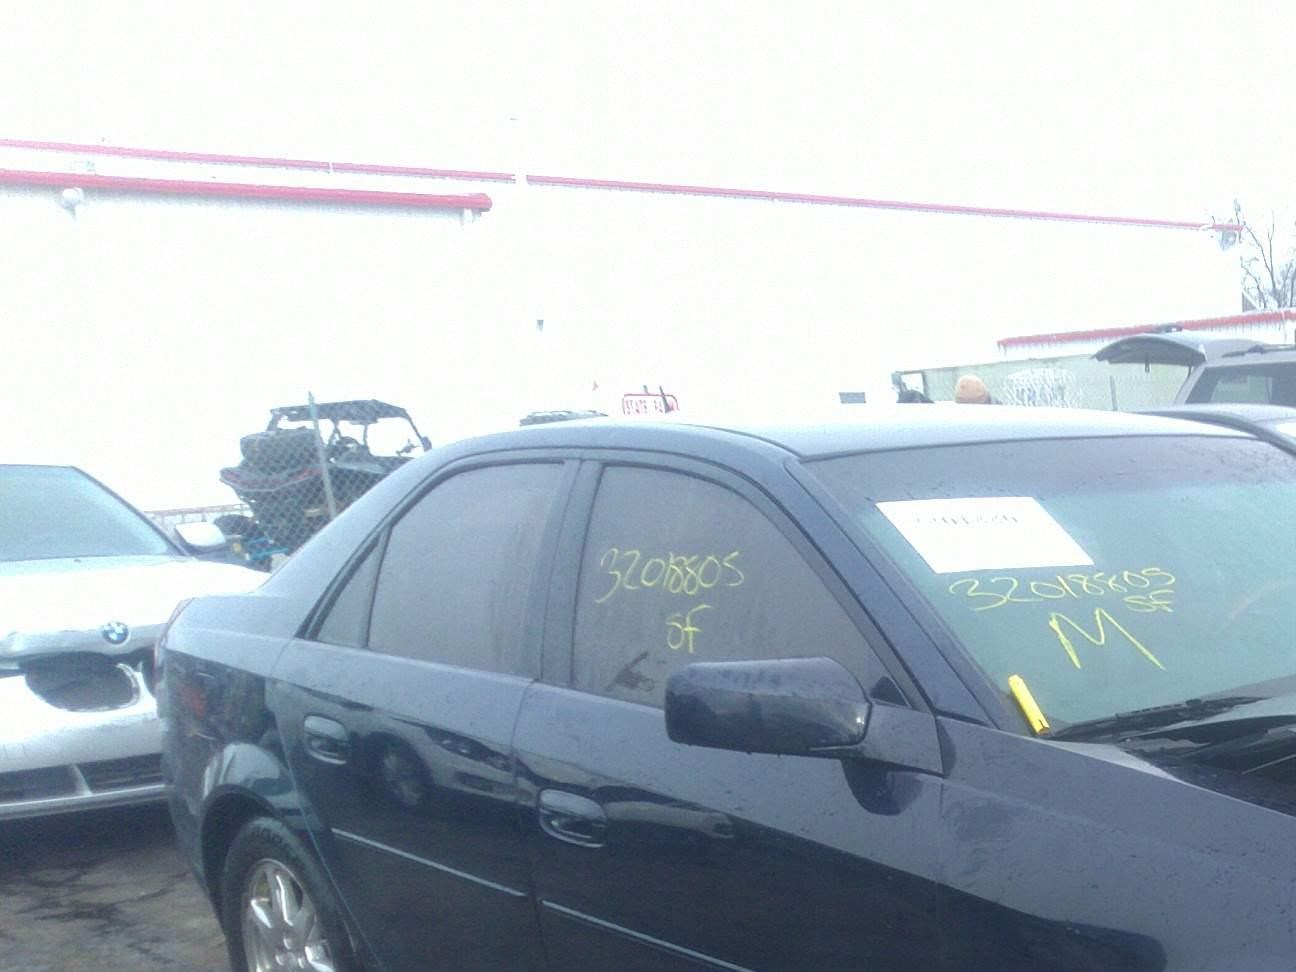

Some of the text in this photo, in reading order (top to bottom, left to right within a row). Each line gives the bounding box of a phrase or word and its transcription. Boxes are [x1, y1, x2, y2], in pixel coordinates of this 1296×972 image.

[595, 547, 745, 604] 32018805
[948, 567, 1176, 612] 32018805
[1048, 607, 1168, 671] M
